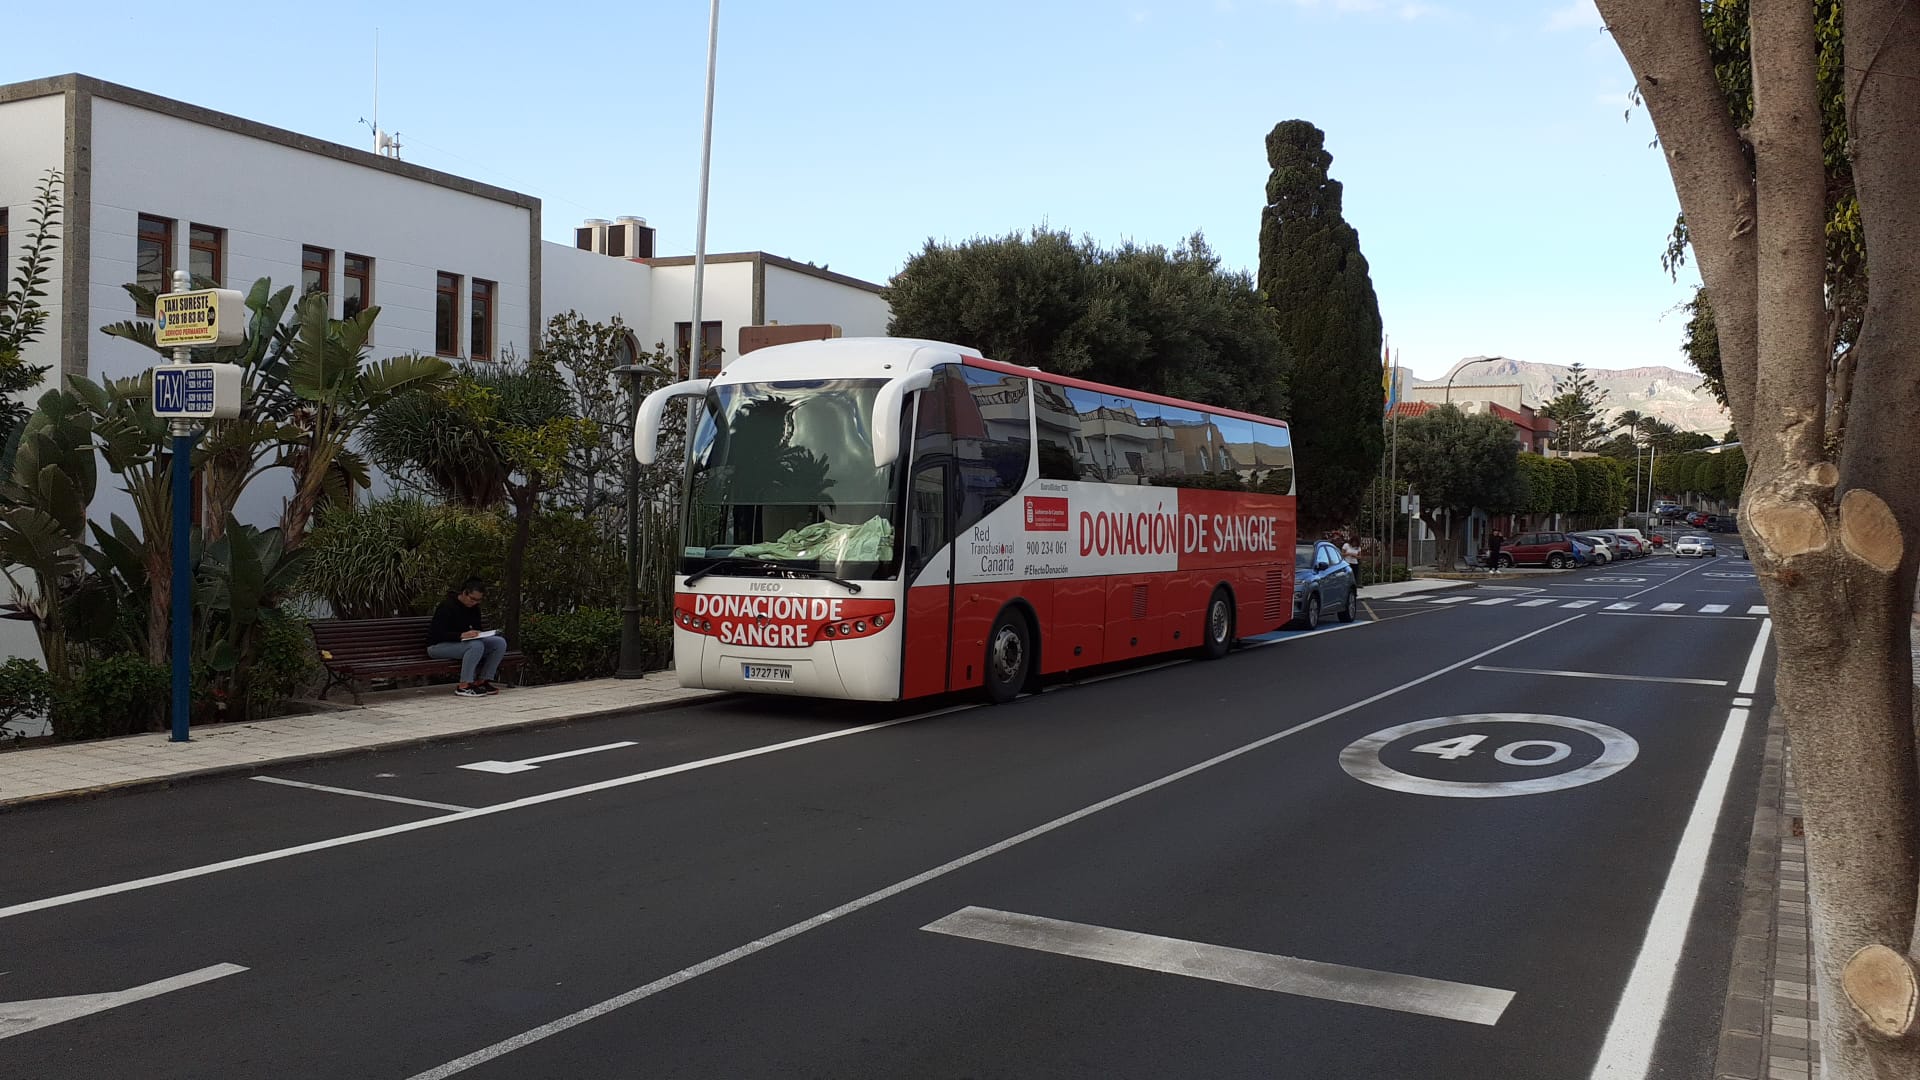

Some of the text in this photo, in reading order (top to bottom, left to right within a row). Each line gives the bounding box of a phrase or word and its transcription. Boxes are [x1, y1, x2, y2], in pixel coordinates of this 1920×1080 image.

[164, 295, 208, 312] TAXI SURESTE
[168, 313, 179, 324] 928
[157, 375, 183, 408] TAXI
[974, 526, 990, 542] Red
[1080, 502, 1277, 557] DONACIÓN DE SANGRE
[1026, 540, 1067, 554] 900 234 061
[981, 555, 1014, 572] Canaria
[1024, 564, 1068, 576] #EfectoDonación
[750, 582, 781, 592] IVECO
[695, 594, 843, 621] DONACION DE
[720, 621, 809, 646] SANGRE
[750, 667, 790, 679] 3727 FVN
[1411, 734, 1572, 766] 40
